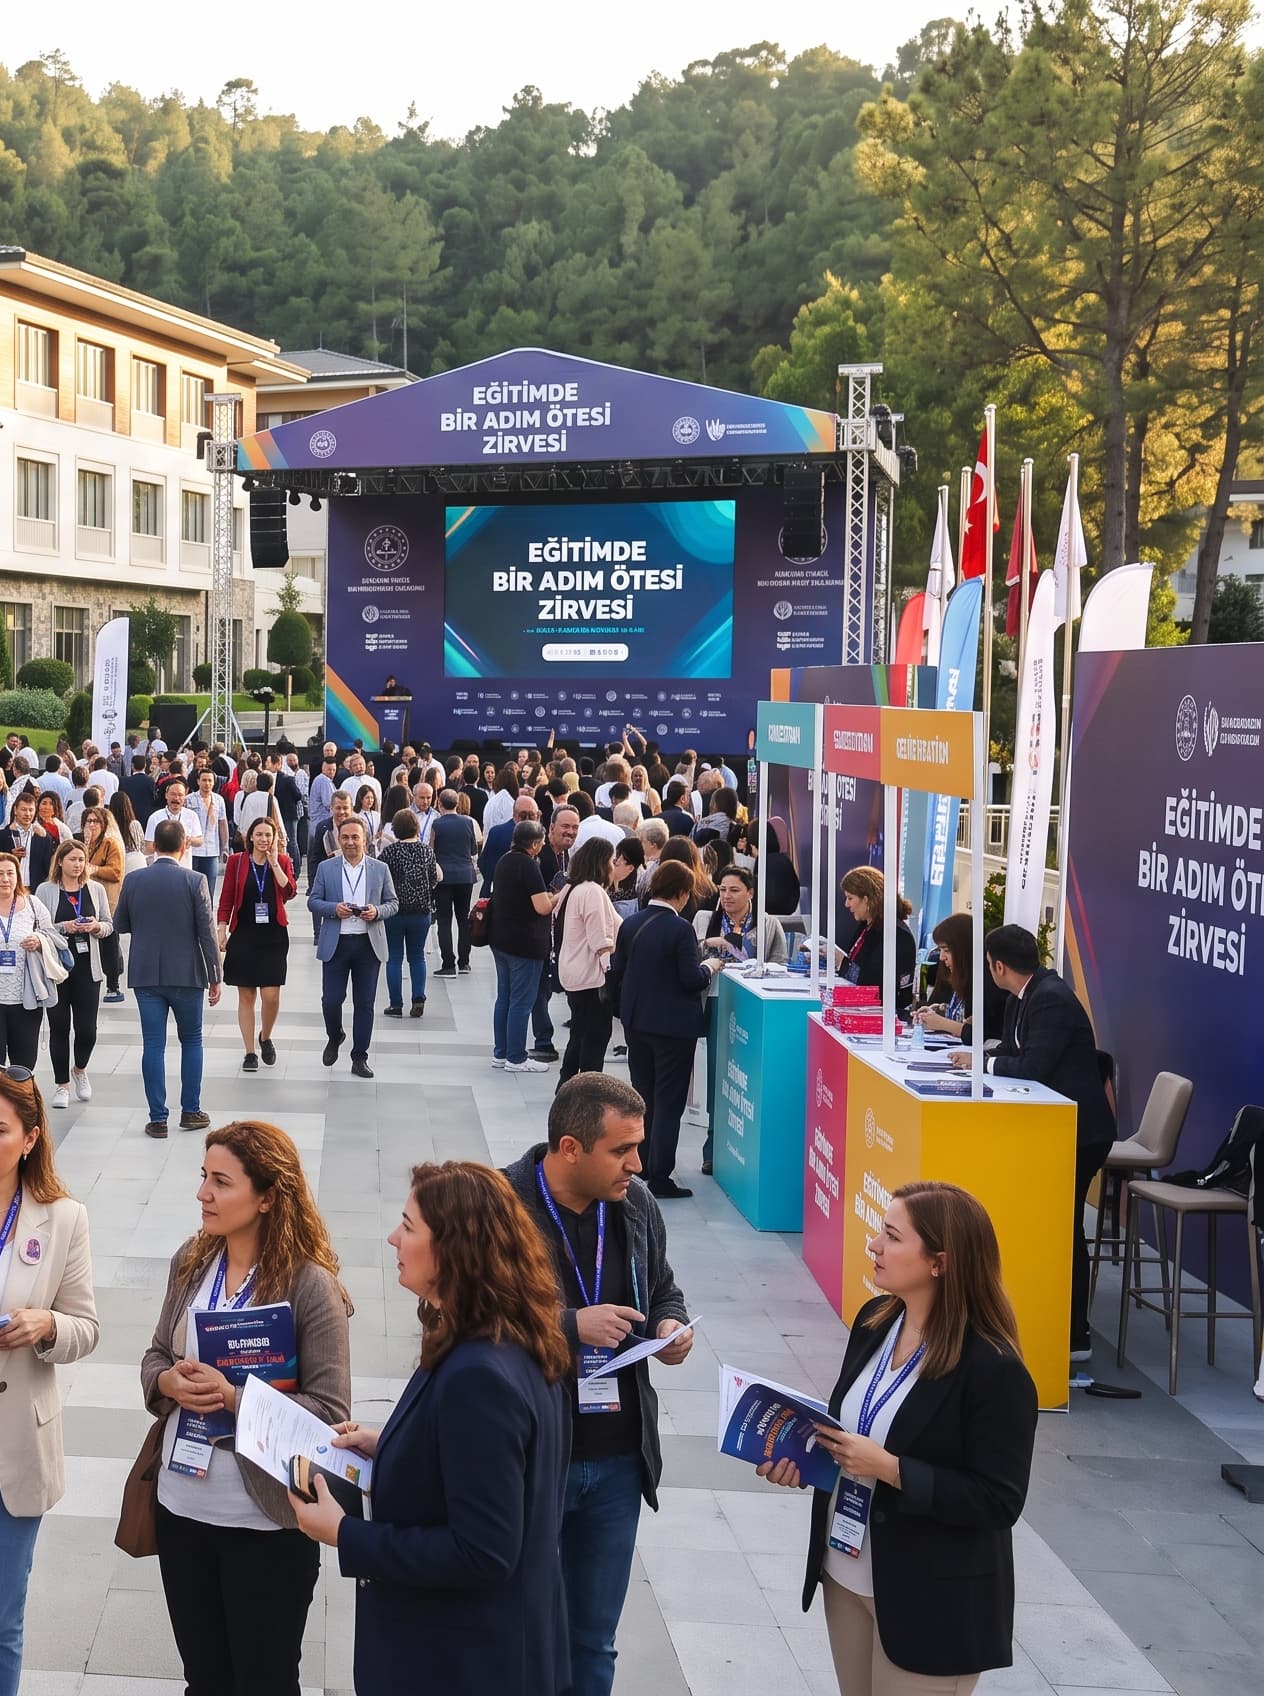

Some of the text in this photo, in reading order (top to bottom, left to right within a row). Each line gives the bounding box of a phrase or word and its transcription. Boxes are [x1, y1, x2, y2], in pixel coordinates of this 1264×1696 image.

[473, 380, 578, 406] EĞİTİMDE
[440, 400, 611, 432] BİR ADIM ÖTESİ
[482, 429, 567, 454] ZİRVESİ
[528, 537, 647, 563] EĞİTİMDE
[493, 564, 683, 592] BİR ADIM ÖTESİ
[538, 594, 634, 620] ZİRVESİ
[1164, 787, 1263, 851] EĞİTİMDE
[1138, 841, 1264, 917] BİR ADIM ÖT
[1167, 906, 1246, 976] ZİRVESİ
